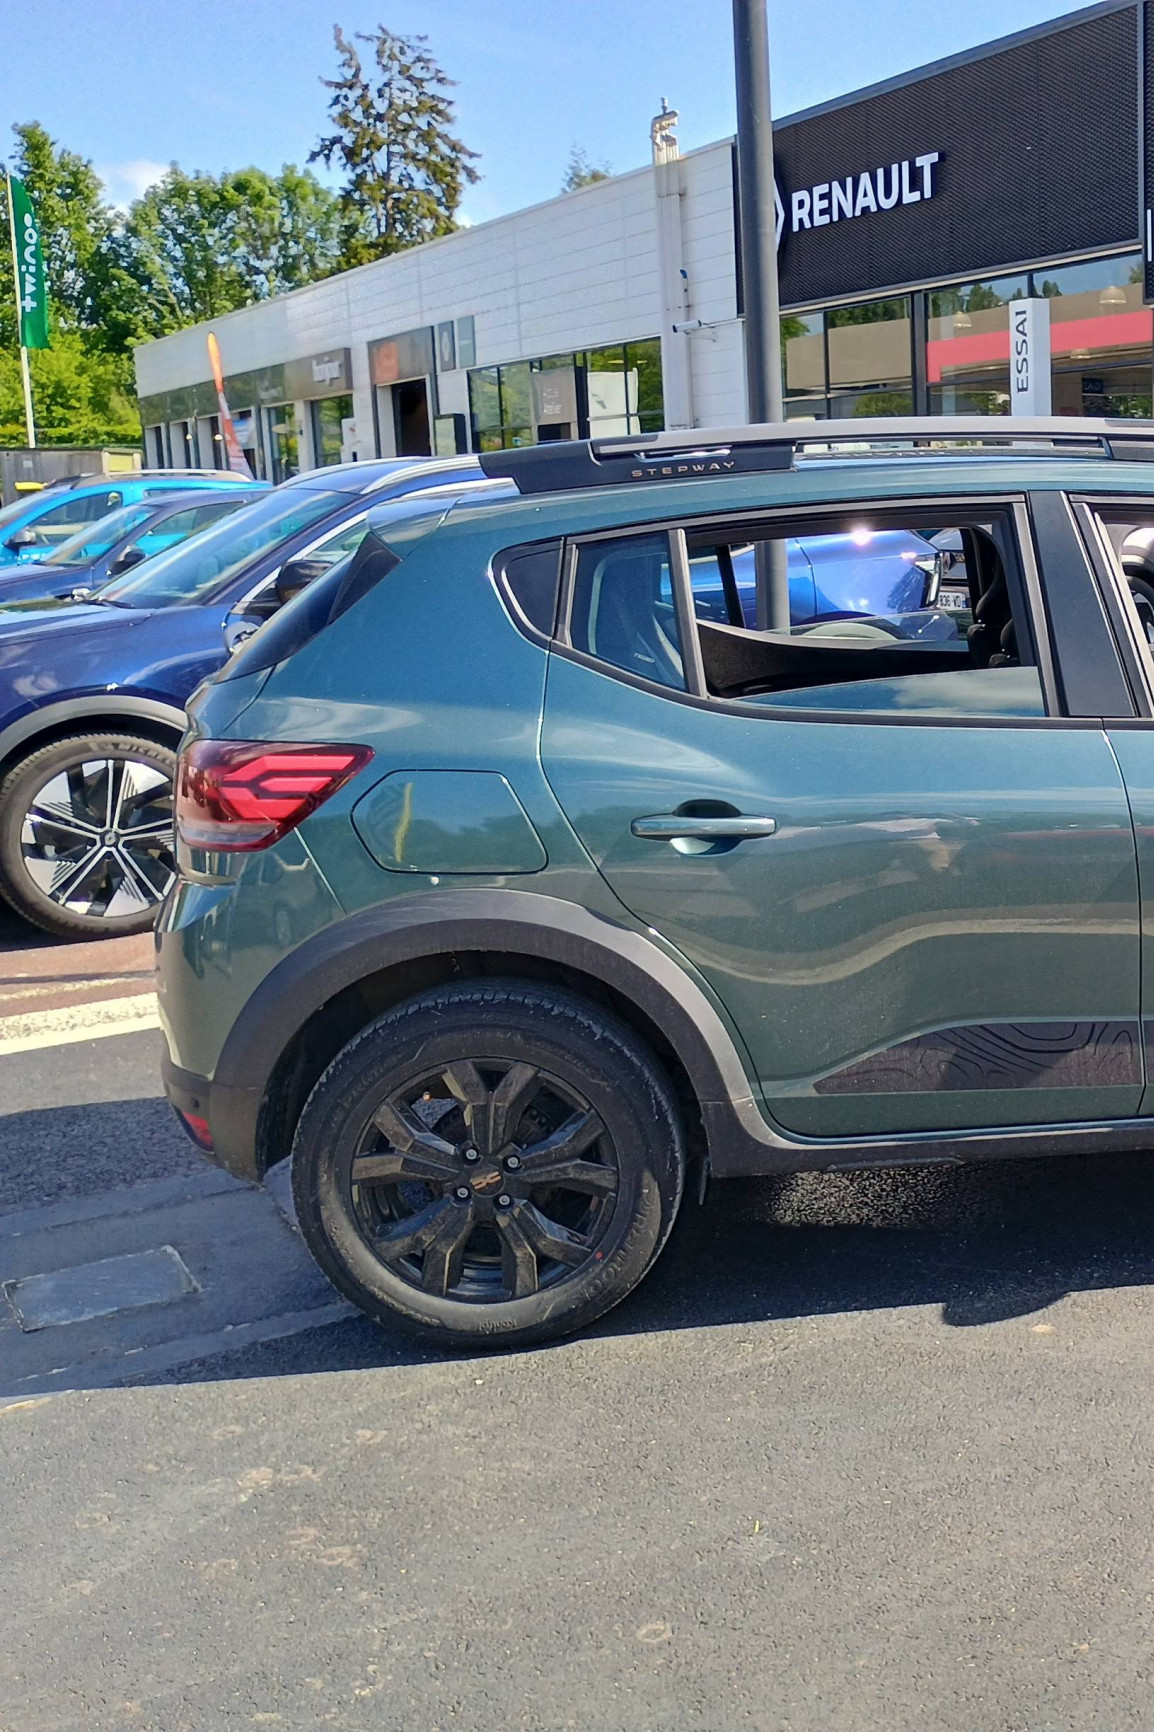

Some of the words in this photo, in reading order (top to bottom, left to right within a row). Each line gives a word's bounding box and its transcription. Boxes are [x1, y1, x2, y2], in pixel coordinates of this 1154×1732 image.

[791, 152, 939, 233] RENAULT
[1015, 309, 1029, 394] ESSAI
[631, 460, 735, 478] STEPWAY
